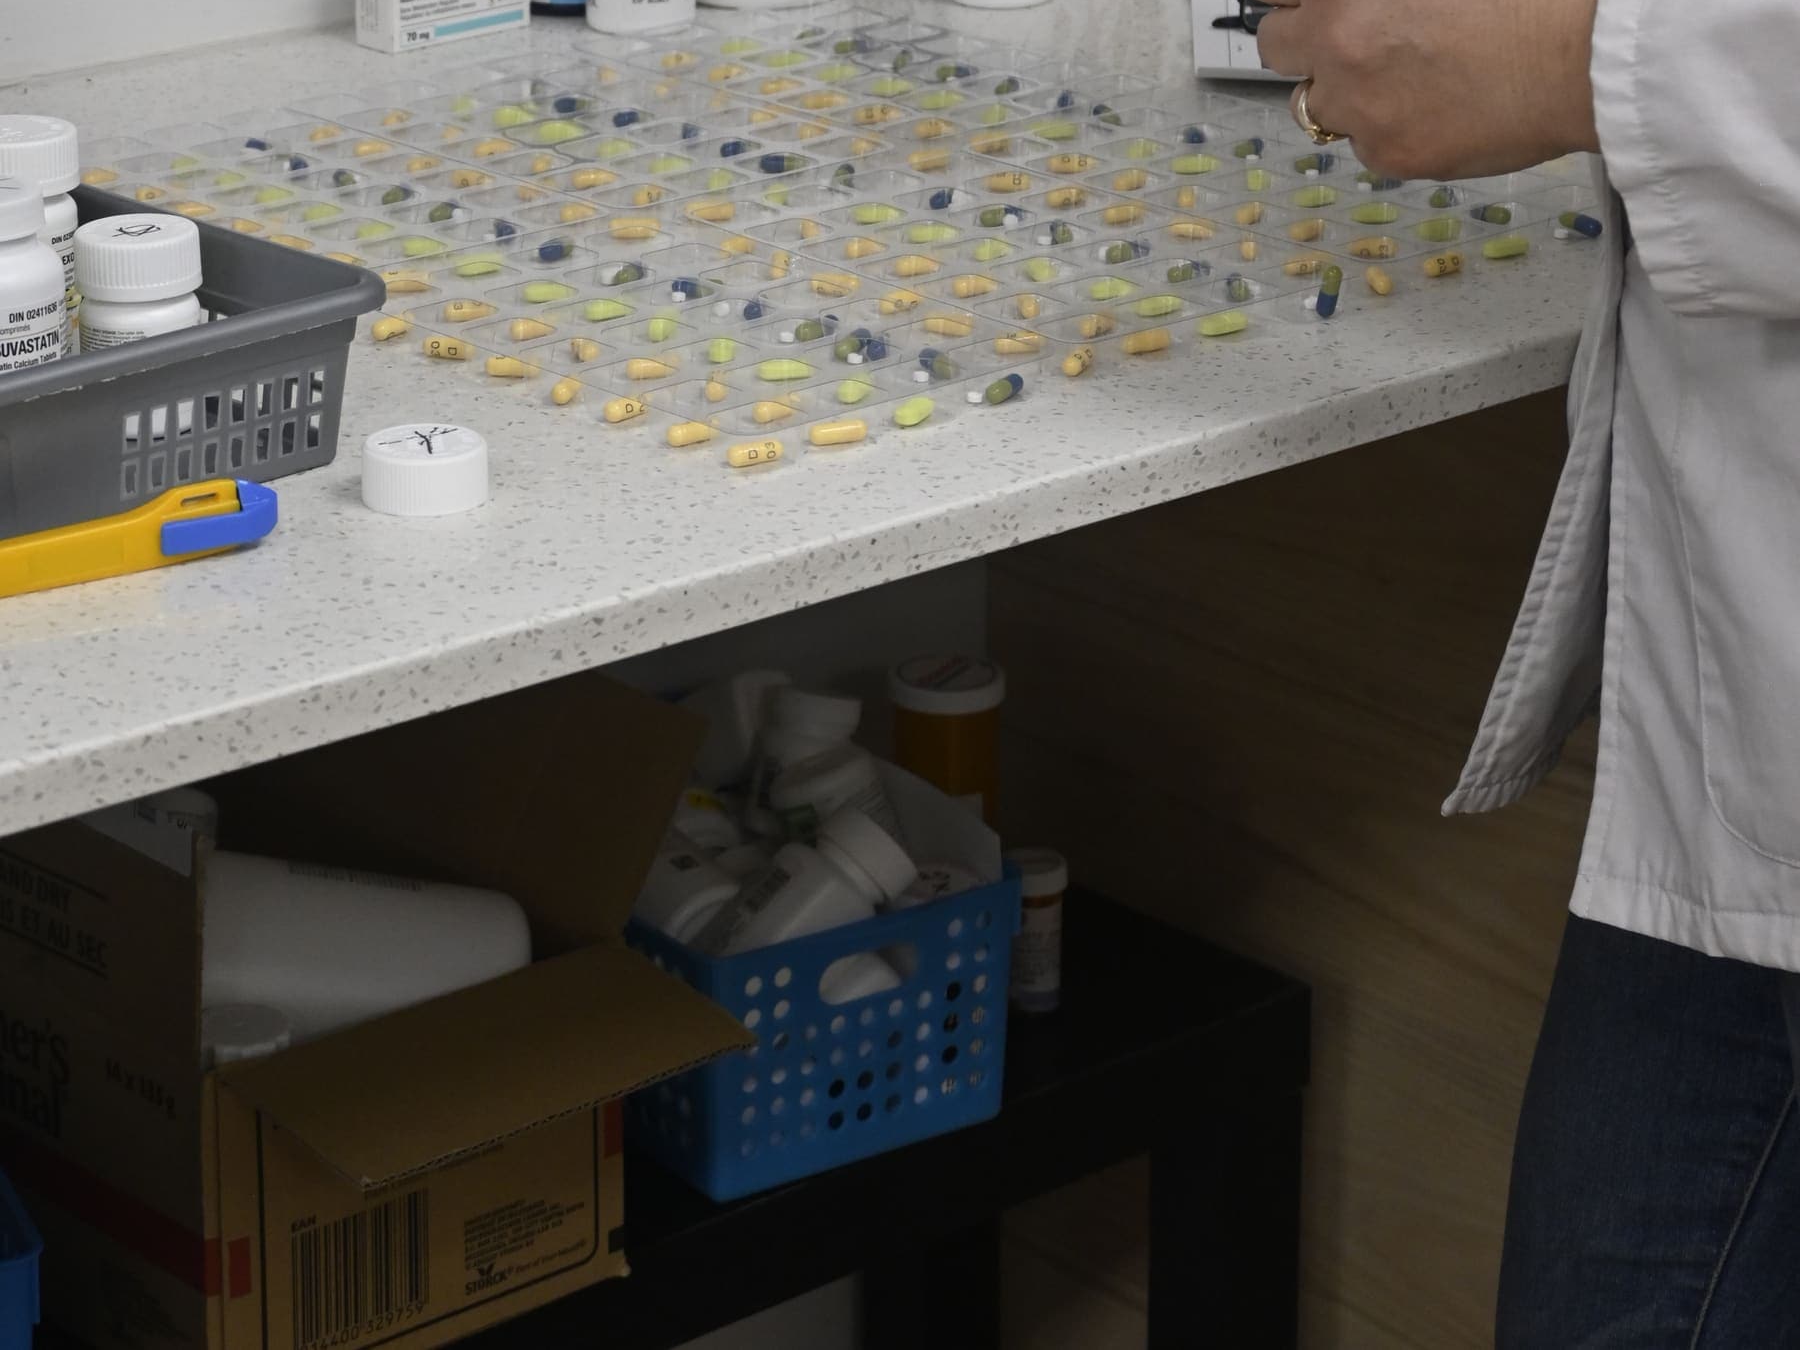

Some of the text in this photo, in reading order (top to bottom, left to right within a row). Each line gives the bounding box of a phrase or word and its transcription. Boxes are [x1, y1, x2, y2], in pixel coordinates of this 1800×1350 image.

[407, 32, 417, 41] 70
[9, 312, 25, 324] DIN
[0, 329, 59, 358] UVASTATIN
[14, 357, 39, 369] Calcium
[40, 350, 57, 363] Tablets
[291, 1213, 316, 1234] EAN
[465, 1269, 506, 1296] STORCK
